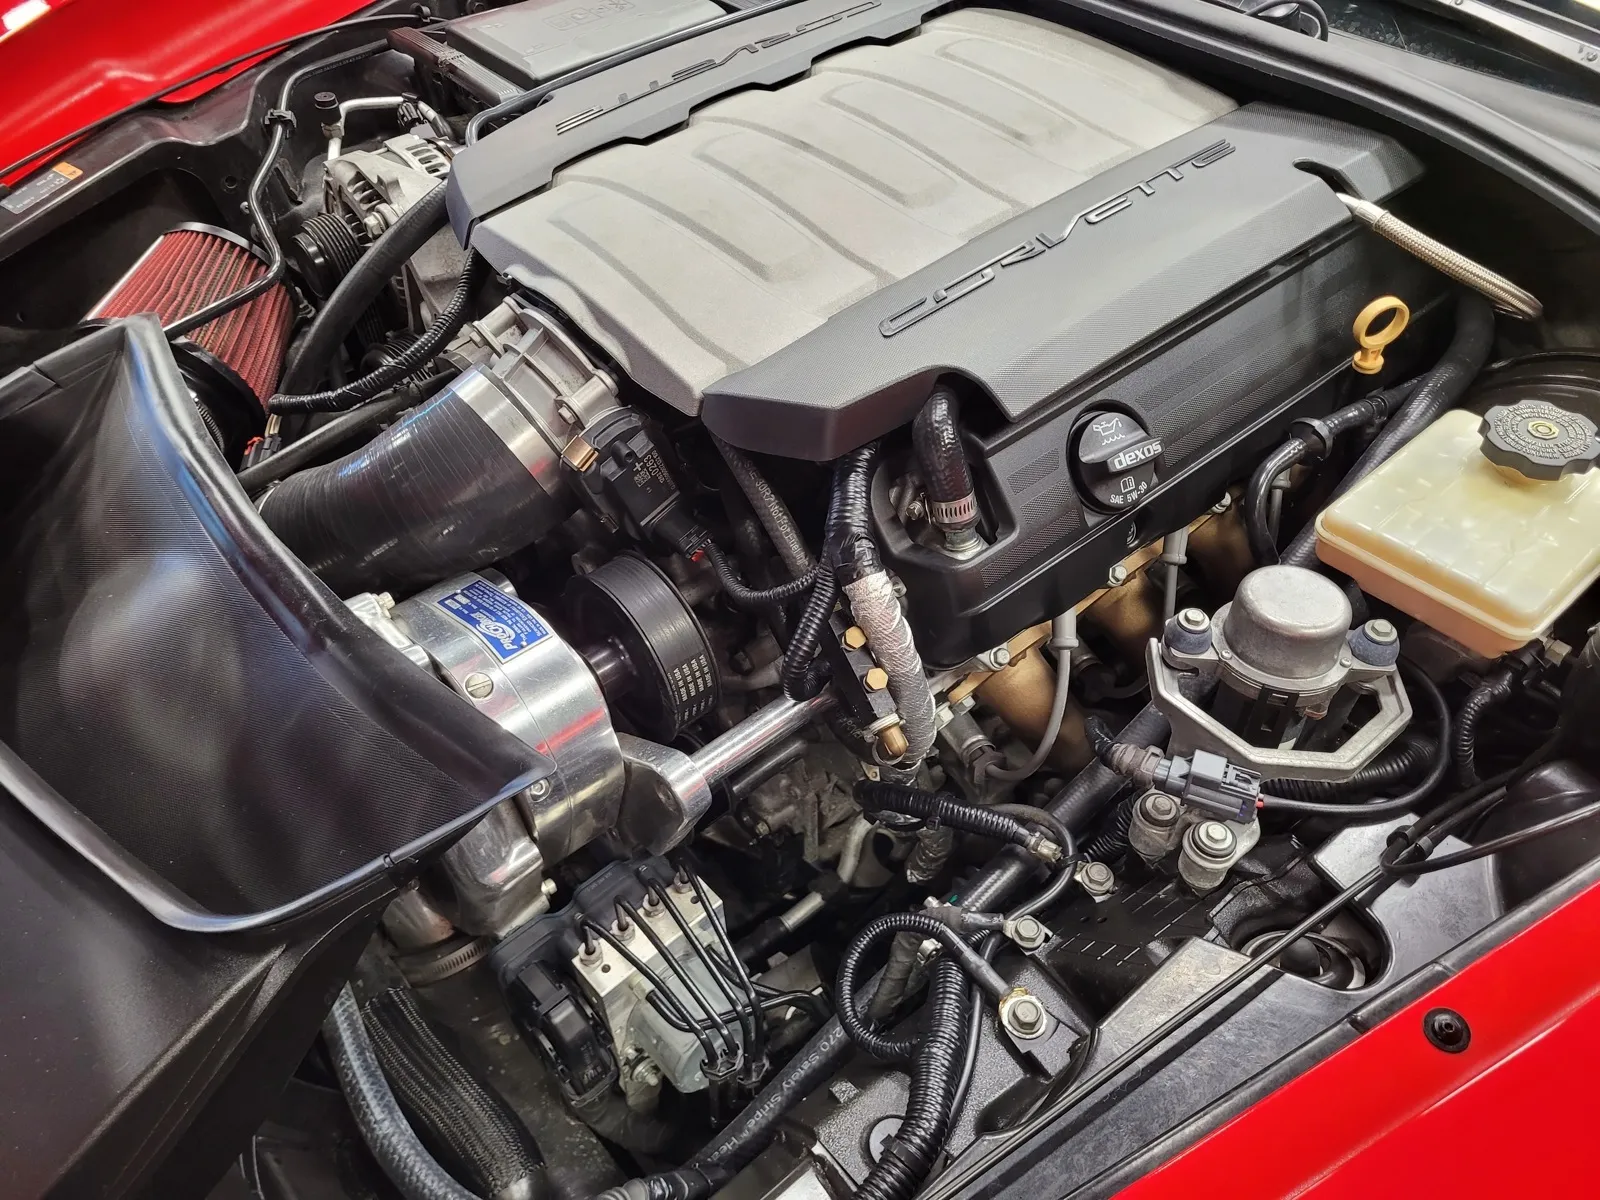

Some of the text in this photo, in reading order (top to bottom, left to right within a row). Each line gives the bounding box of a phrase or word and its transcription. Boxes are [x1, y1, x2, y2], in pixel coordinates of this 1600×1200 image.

[556, 1, 881, 135] CORVETTE
[878, 139, 1236, 337] CORVETTE
[1113, 440, 1162, 469] dexos
[756, 480, 776, 501] 30R7
[768, 501, 783, 520] Not
[1110, 481, 1148, 504] SAE 5W-30
[820, 1026, 845, 1052] 270
[781, 1052, 820, 1092] Safety
[707, 1136, 739, 1162] Hea
